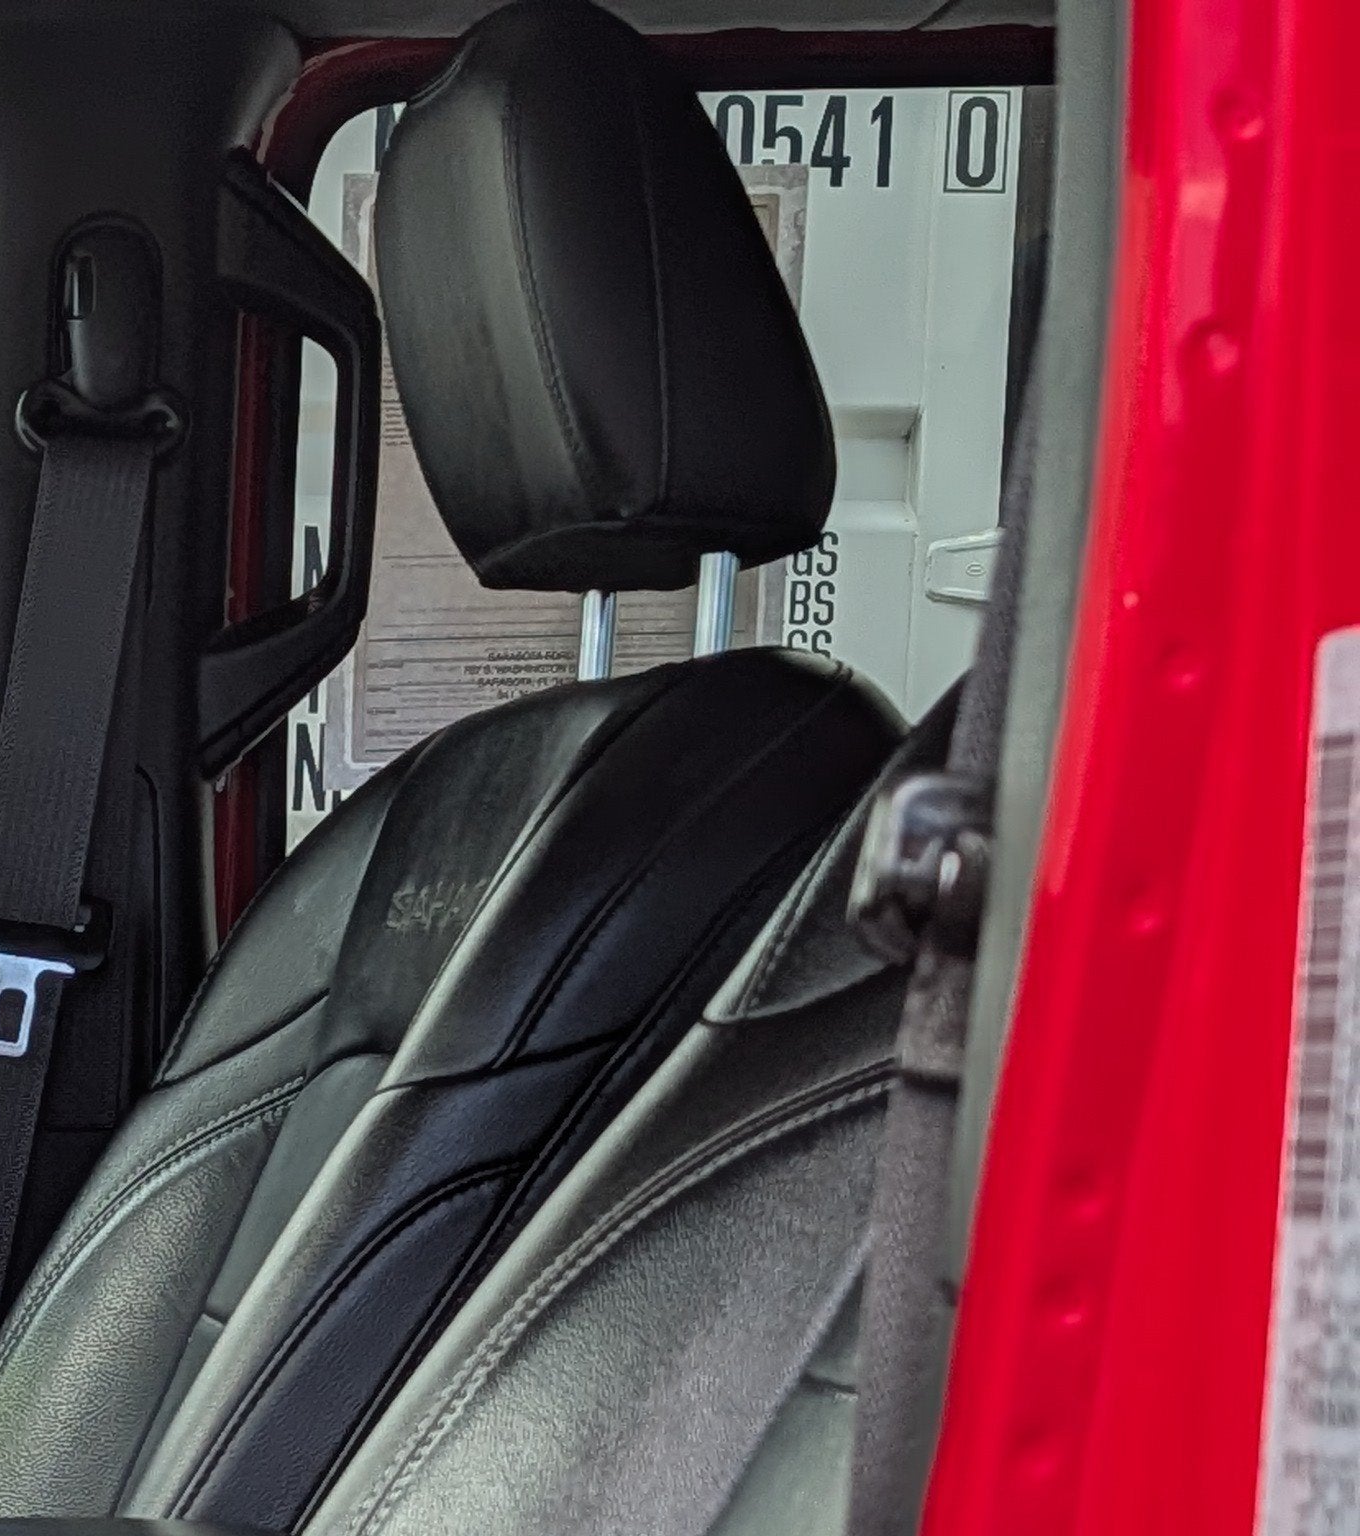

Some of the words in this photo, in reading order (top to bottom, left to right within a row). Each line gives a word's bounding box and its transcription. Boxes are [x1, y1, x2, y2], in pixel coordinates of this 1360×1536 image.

[956, 96, 999, 188] 0
[793, 531, 839, 577] GS
[788, 580, 836, 626] BS
